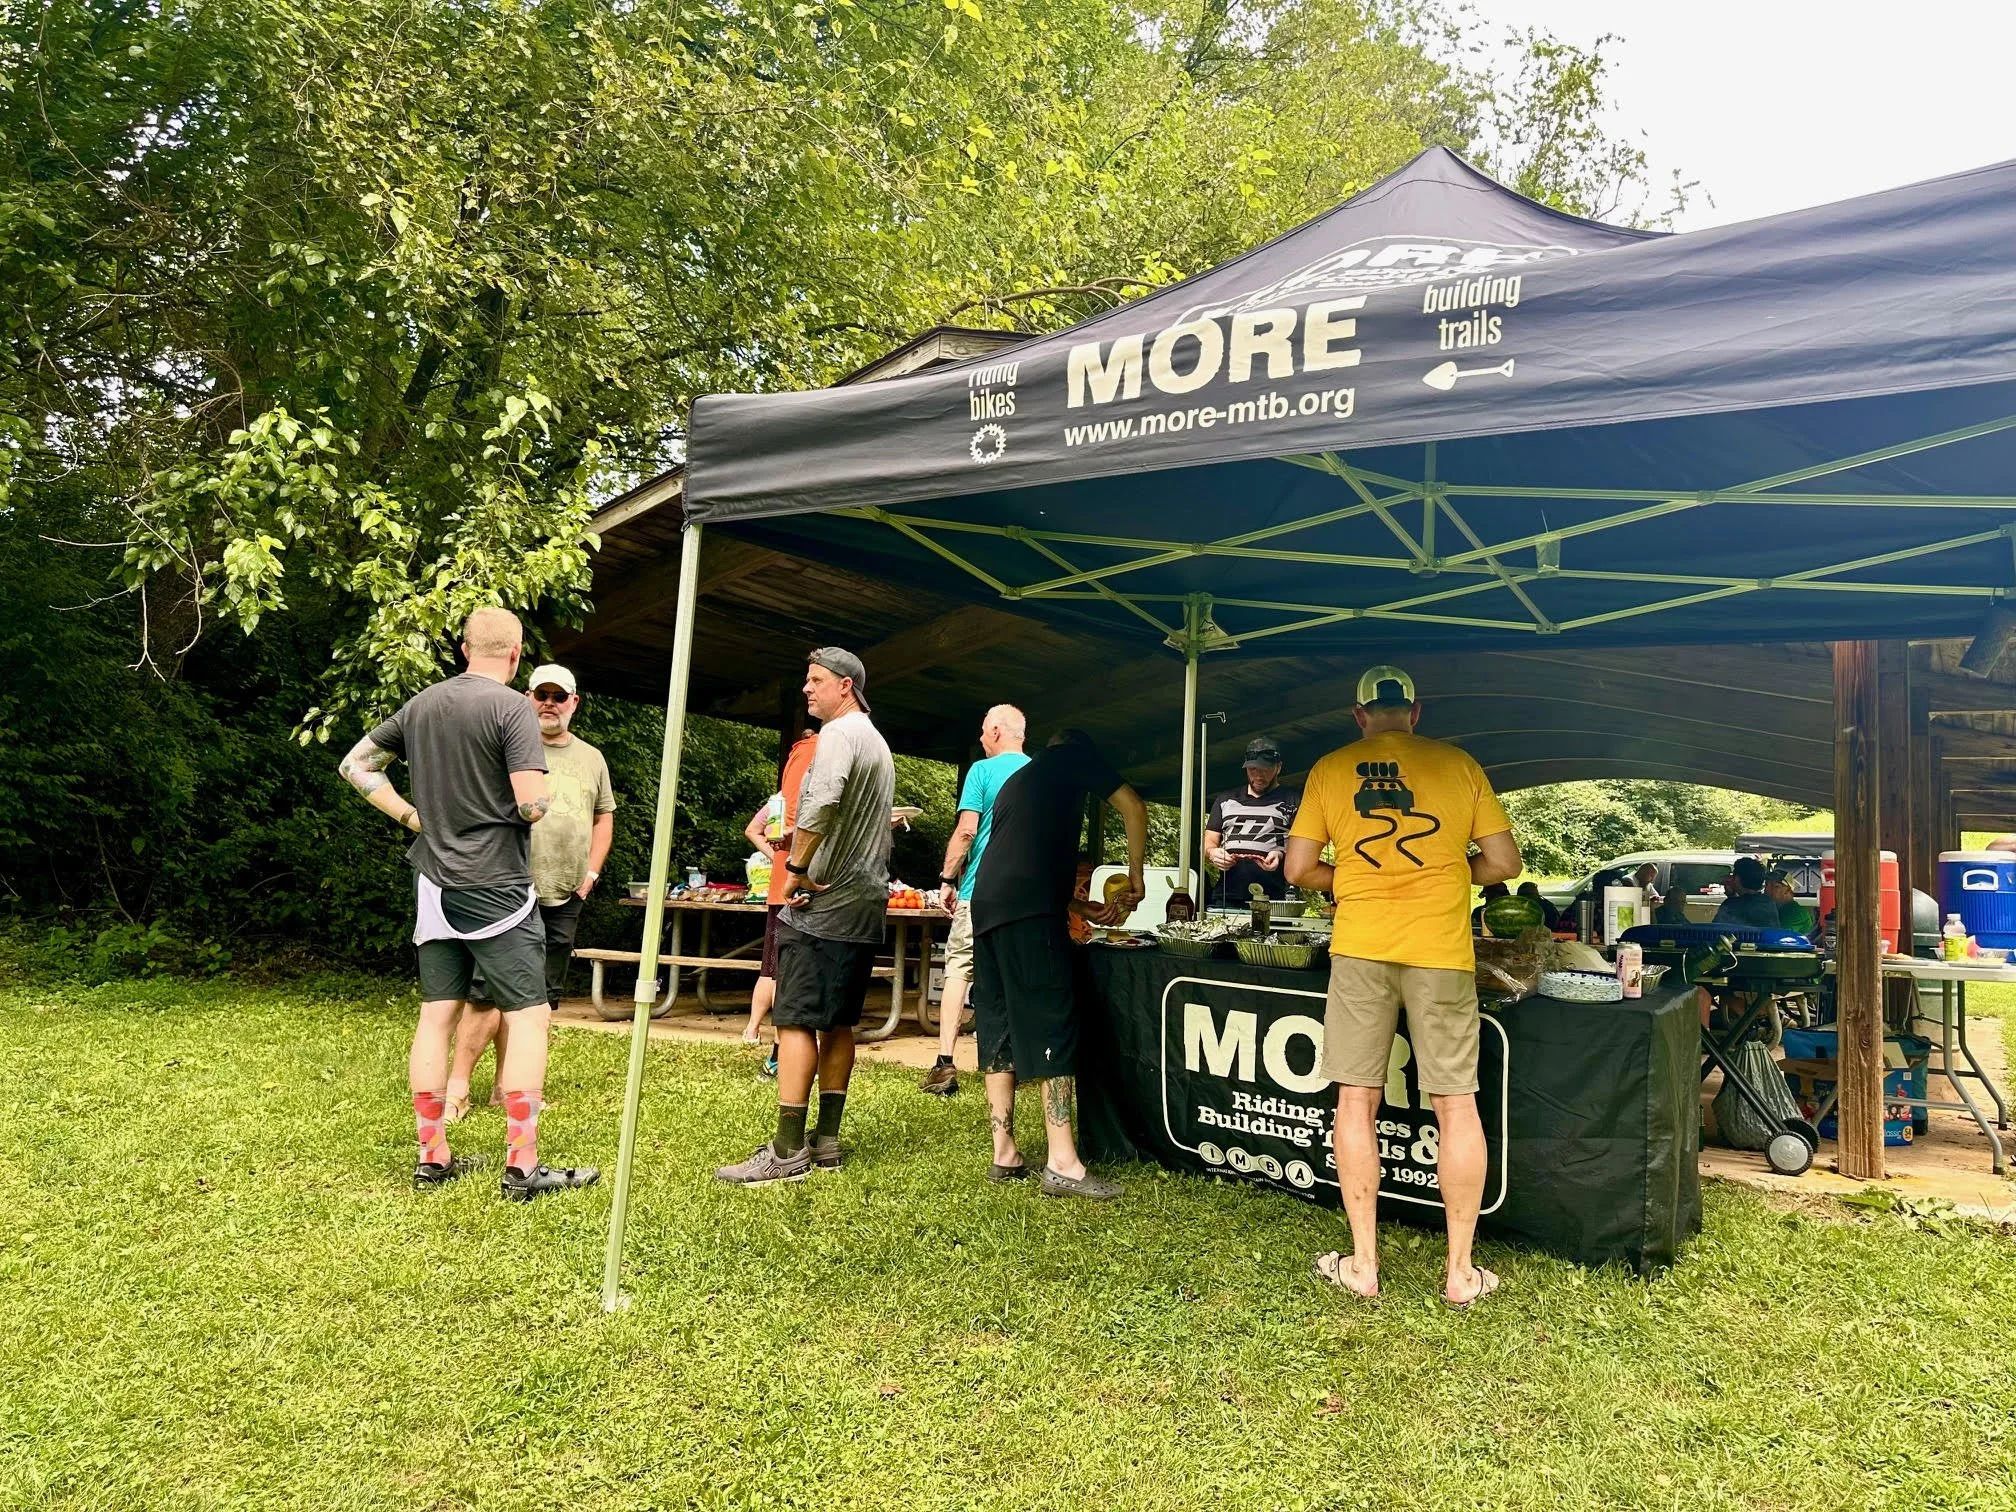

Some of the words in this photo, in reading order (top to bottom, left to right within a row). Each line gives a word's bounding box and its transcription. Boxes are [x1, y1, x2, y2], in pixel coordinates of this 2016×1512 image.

[1422, 274, 1522, 314] building
[1438, 312, 1503, 351] trails
[1067, 296, 1367, 409] MORE
[969, 388, 1016, 421] bikes
[1064, 388, 1356, 447] www.more-mtb.org
[1198, 1106, 1313, 1147] Building
[1232, 1091, 1325, 1127] Riding
[1411, 1125, 1440, 1165] &
[1391, 1167, 1440, 1189] 1992
